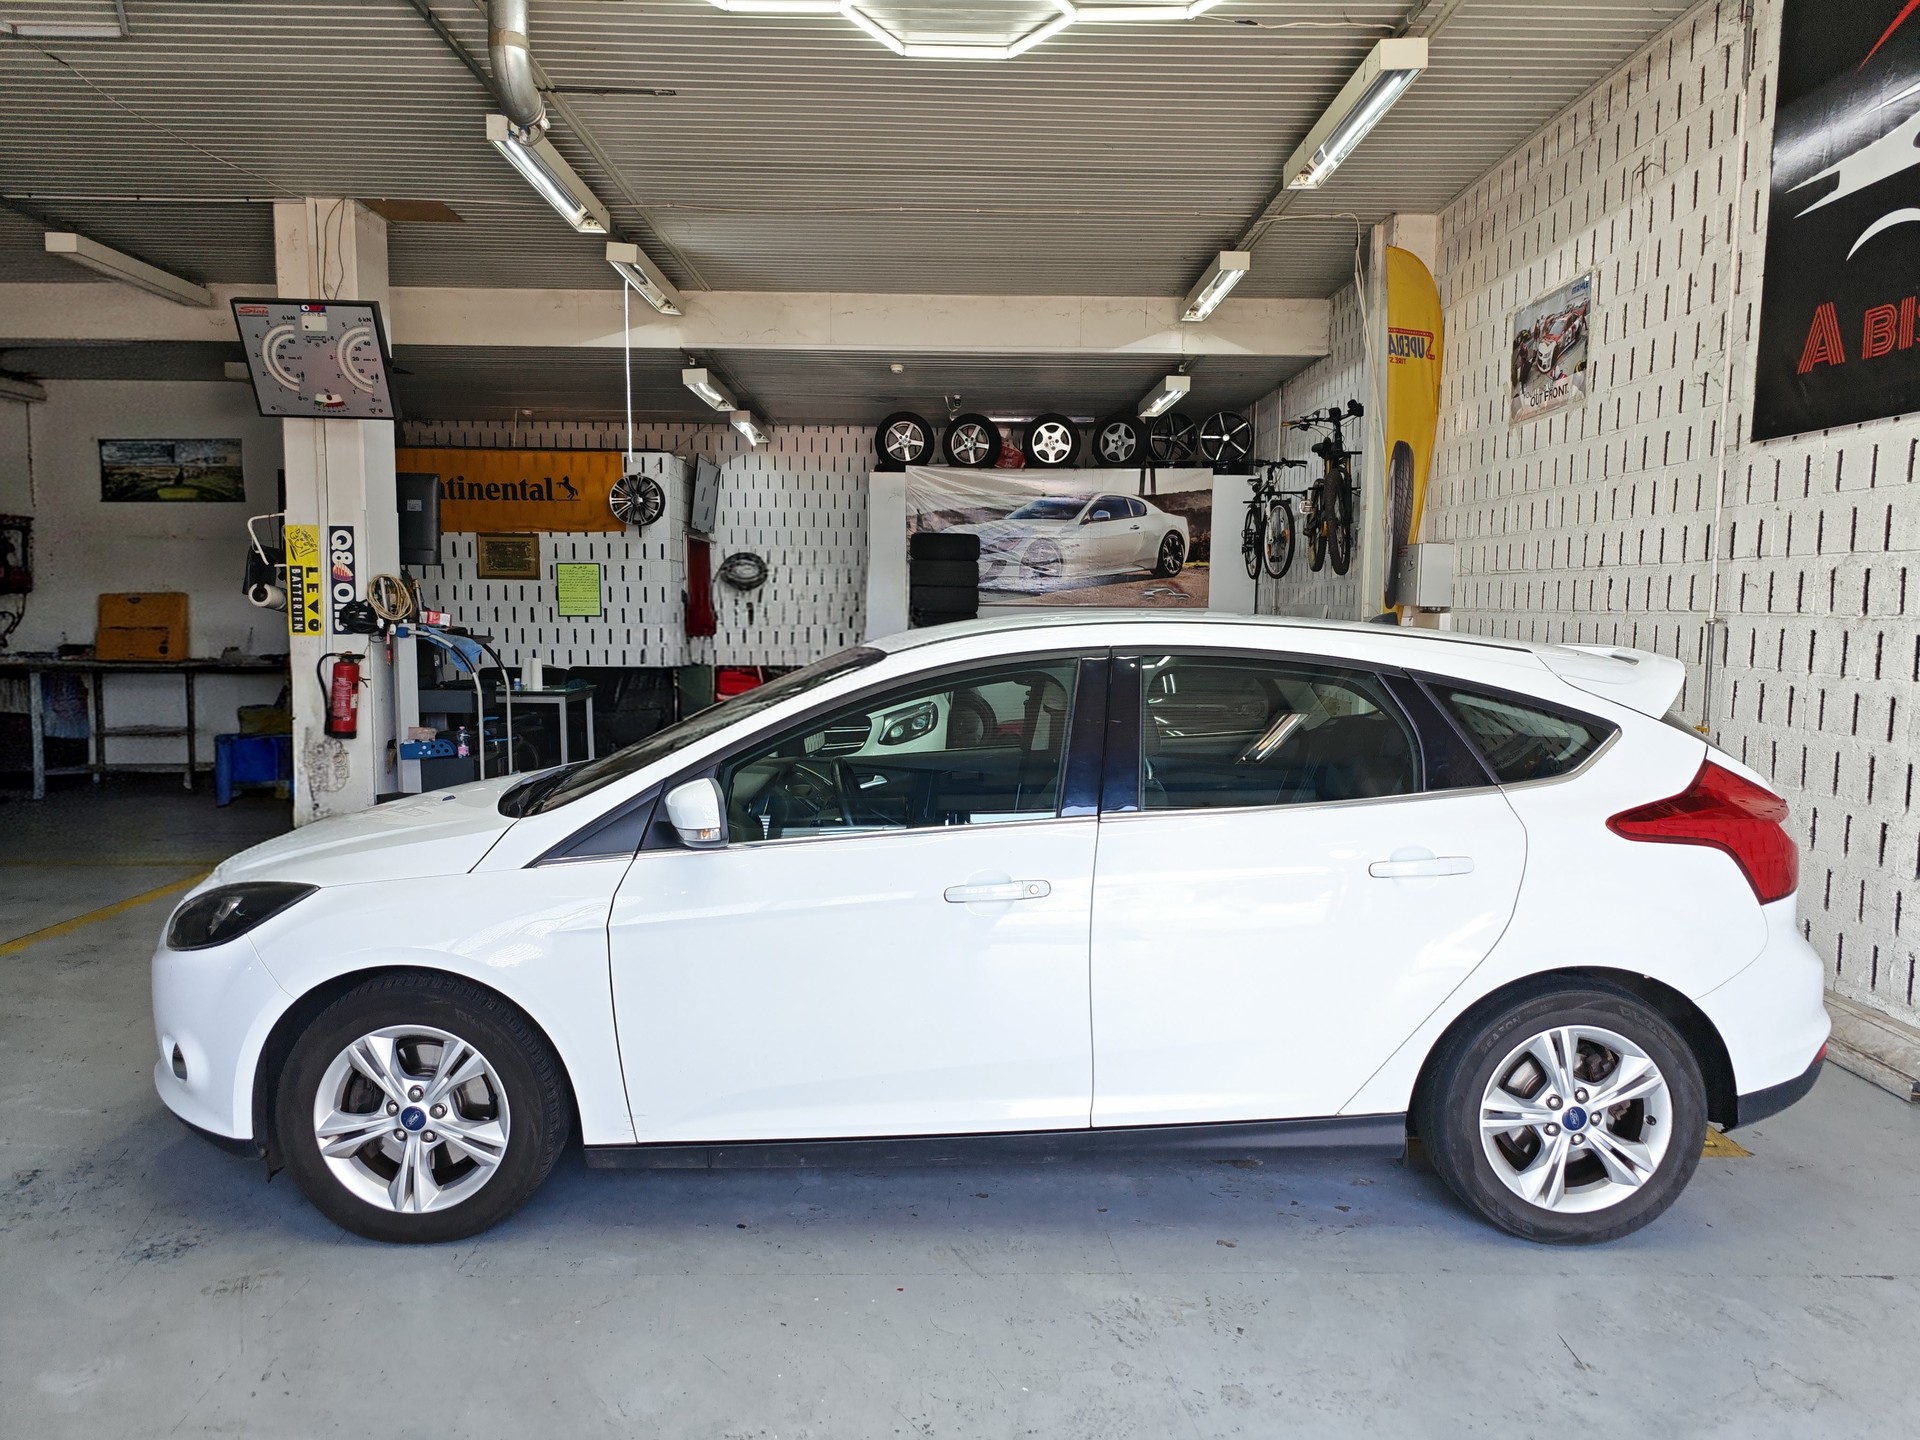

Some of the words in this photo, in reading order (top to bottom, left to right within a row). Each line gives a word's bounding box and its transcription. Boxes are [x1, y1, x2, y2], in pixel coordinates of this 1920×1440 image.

[1797, 301, 1846, 375] A
[1861, 295, 1920, 361] BI
[331, 529, 354, 565] Q8
[291, 568, 303, 630] BATTERIEN
[306, 567, 322, 632] LEVO
